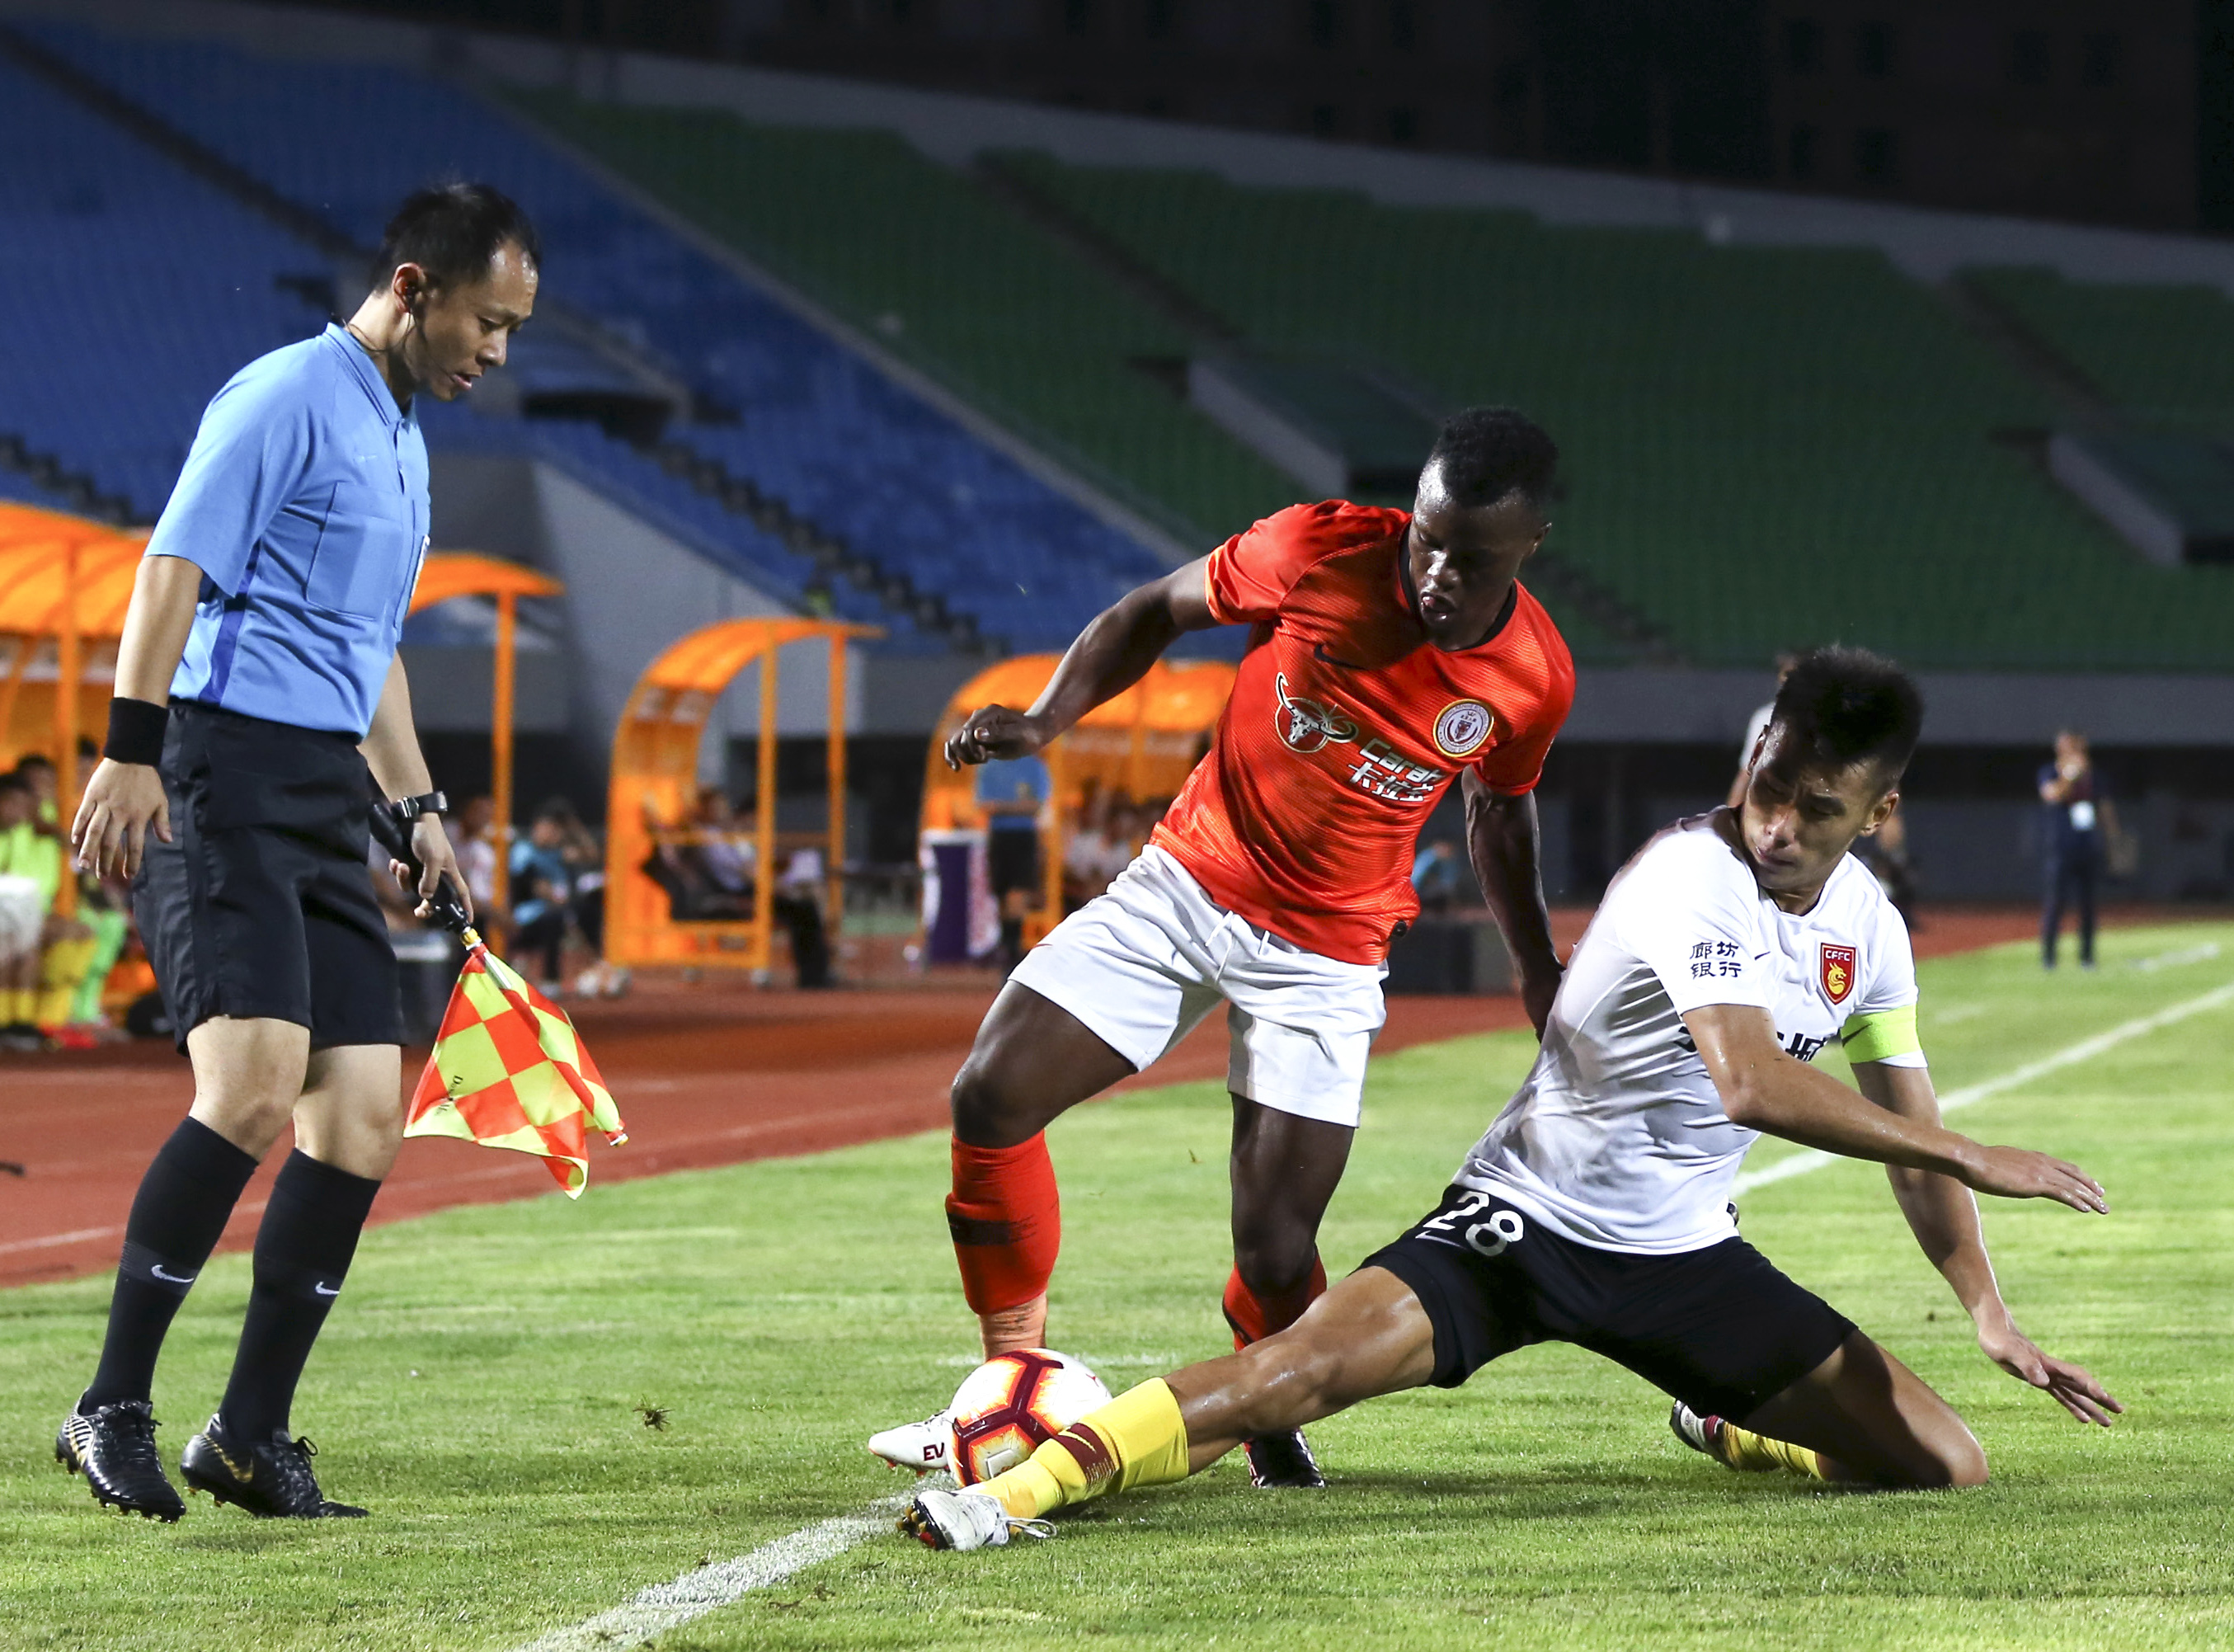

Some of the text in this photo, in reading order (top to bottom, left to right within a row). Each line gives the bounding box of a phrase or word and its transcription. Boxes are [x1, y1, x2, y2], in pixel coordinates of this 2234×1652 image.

[1689, 941, 1739, 960] 廊坊
[1825, 949, 1851, 962] CFFC
[1691, 961, 1742, 980] 银行
[1422, 1190, 1524, 1257] 28
